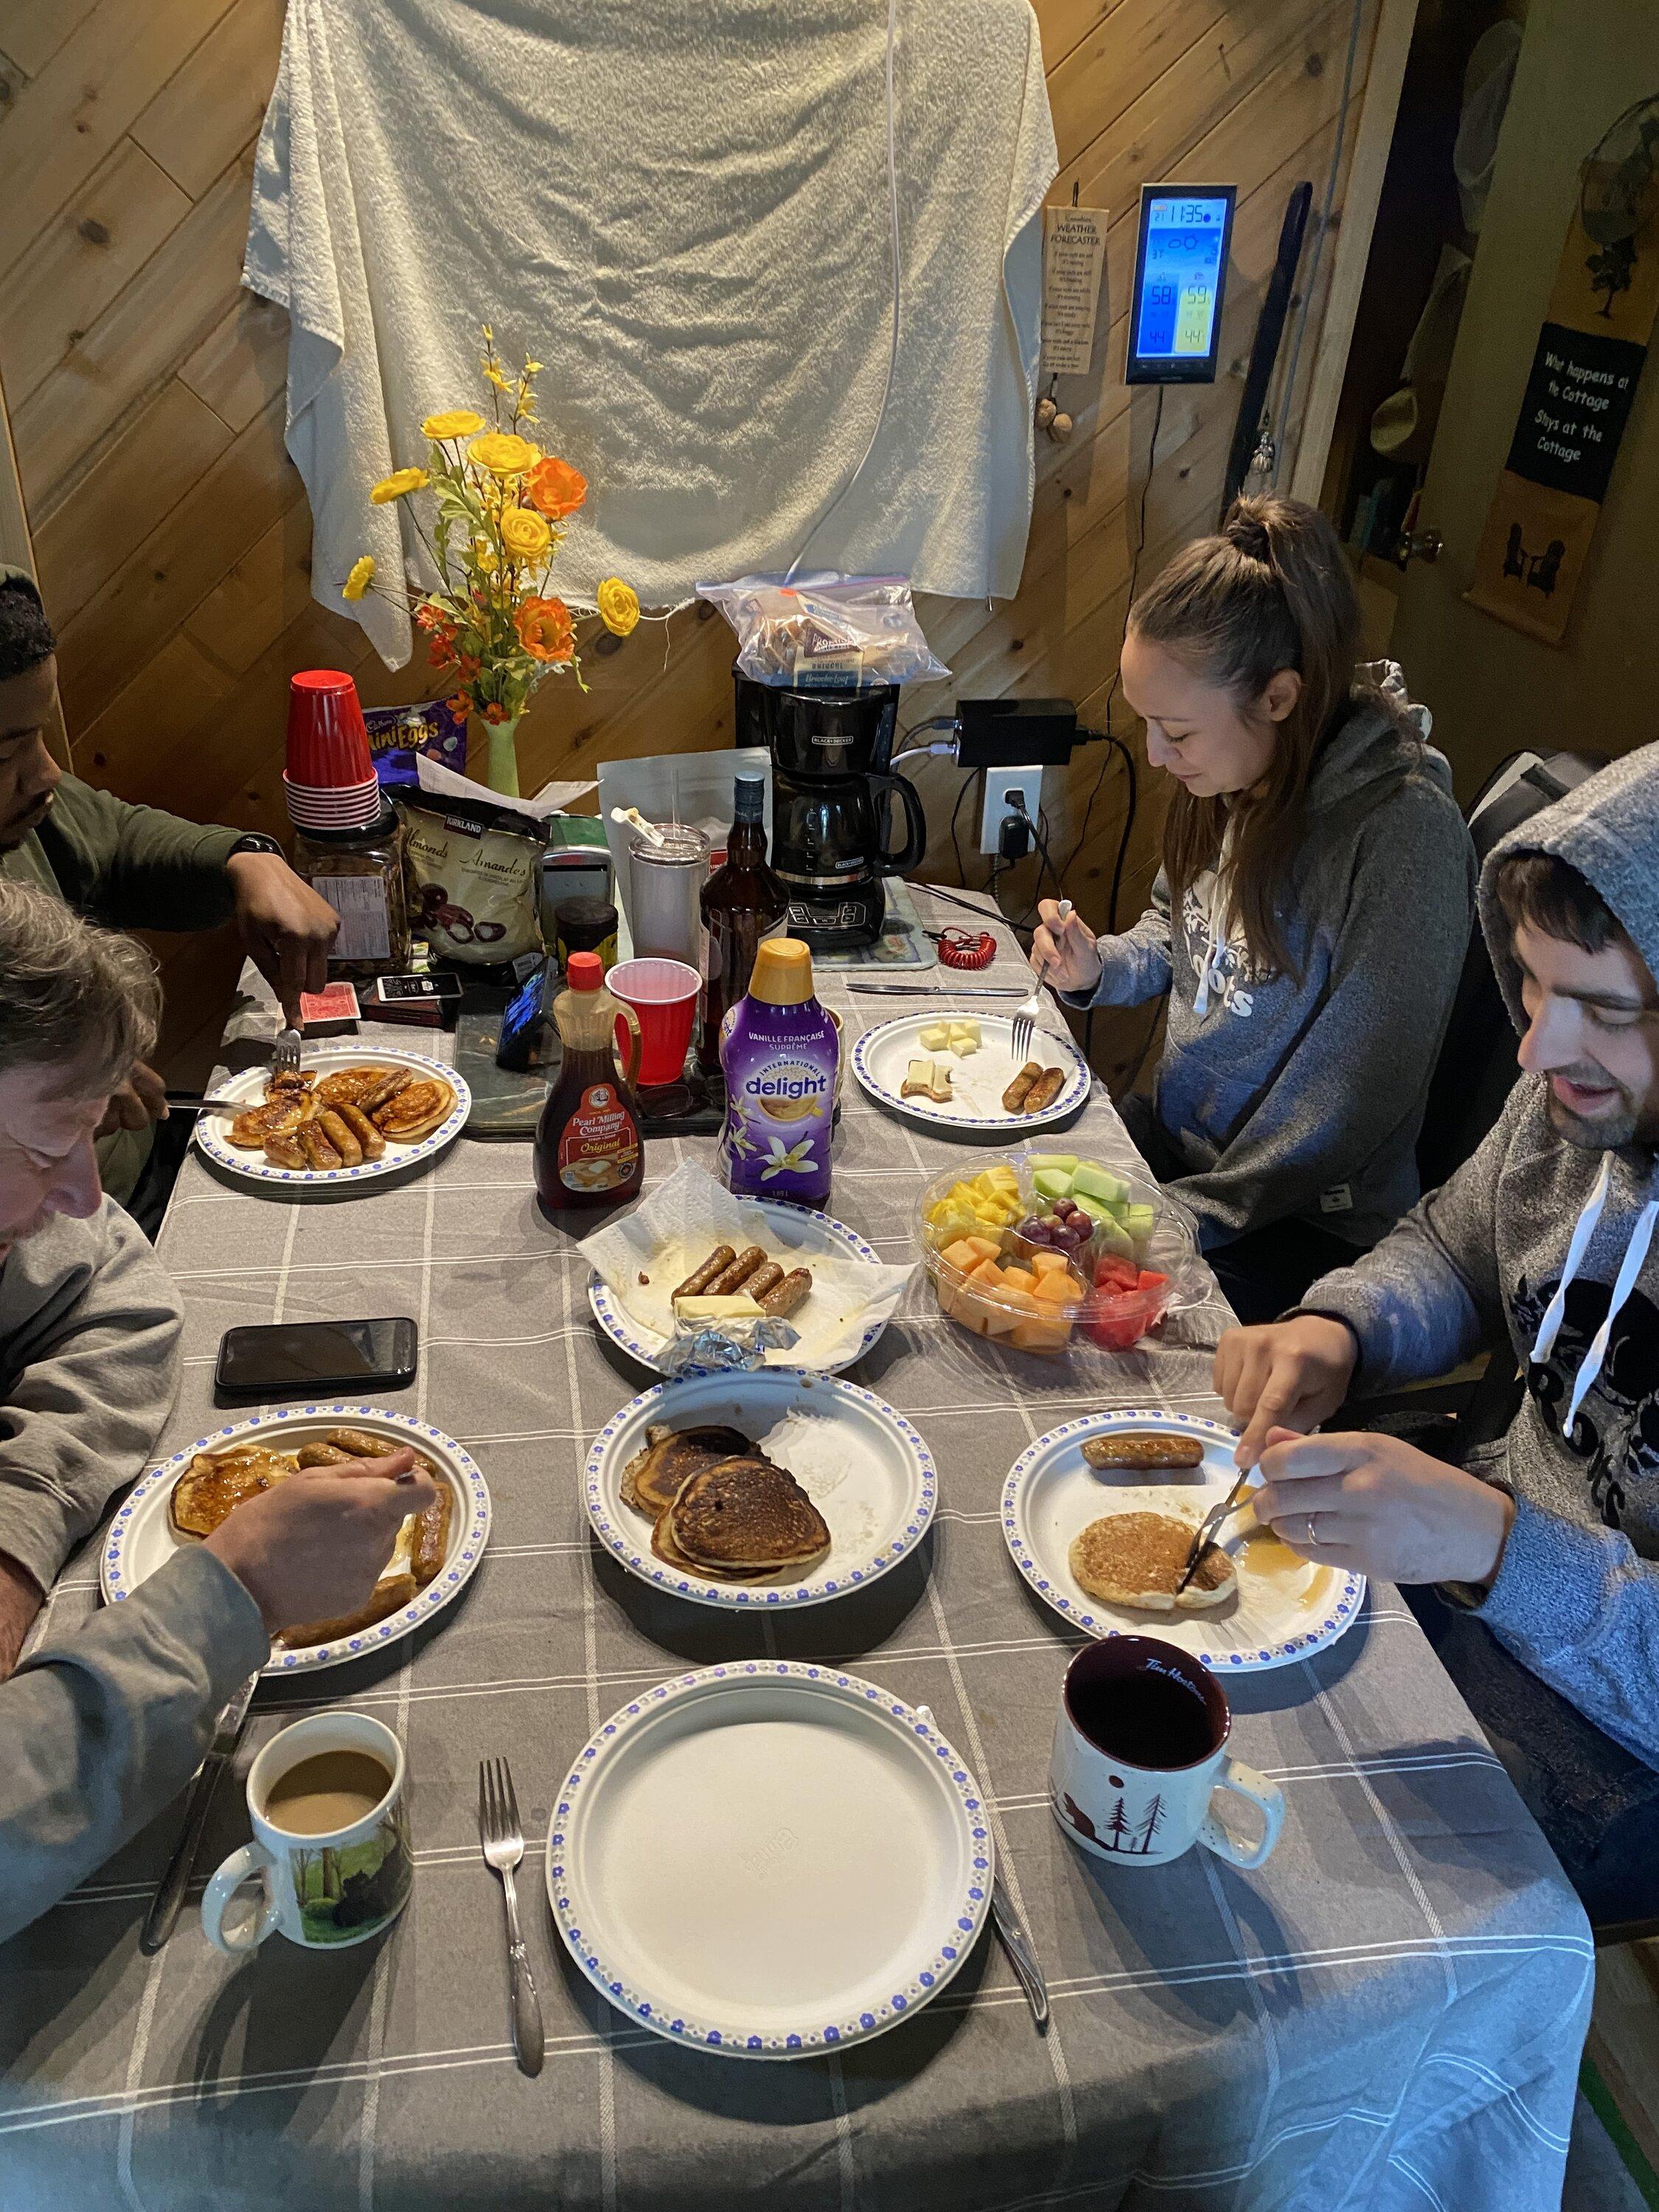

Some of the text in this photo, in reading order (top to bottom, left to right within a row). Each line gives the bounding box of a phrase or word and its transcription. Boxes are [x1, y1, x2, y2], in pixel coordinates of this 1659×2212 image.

[1057, 224, 1096, 234] WEATHER
[1051, 234, 1100, 246] FORECASTER
[1152, 285, 1172, 305] 58
[1188, 285, 1207, 305] 59
[1185, 330, 1200, 344] 44
[1566, 360, 1615, 385] happens
[1618, 376, 1630, 389] at
[1563, 386, 1609, 411] Cottage
[1562, 422, 1577, 436] at
[1582, 424, 1603, 442] the
[1537, 436, 1581, 463] Cottage
[398, 722, 439, 749] Eggs
[447, 815, 481, 833] KIRKLAND
[459, 849, 526, 876] Amandes
[748, 1030, 824, 1043] VANILLE FRANÇAISE
[769, 1043, 807, 1051] SUPRÊME
[759, 1060, 821, 1077] INTERNATIONAL
[745, 1075, 827, 1099] delight
[572, 1117, 596, 1127] Pearl
[597, 1111, 625, 1124] Milling
[580, 1121, 619, 1135] Company
[580, 1138, 621, 1152] Original
[1145, 1658, 1208, 1706] Tim Hortons
